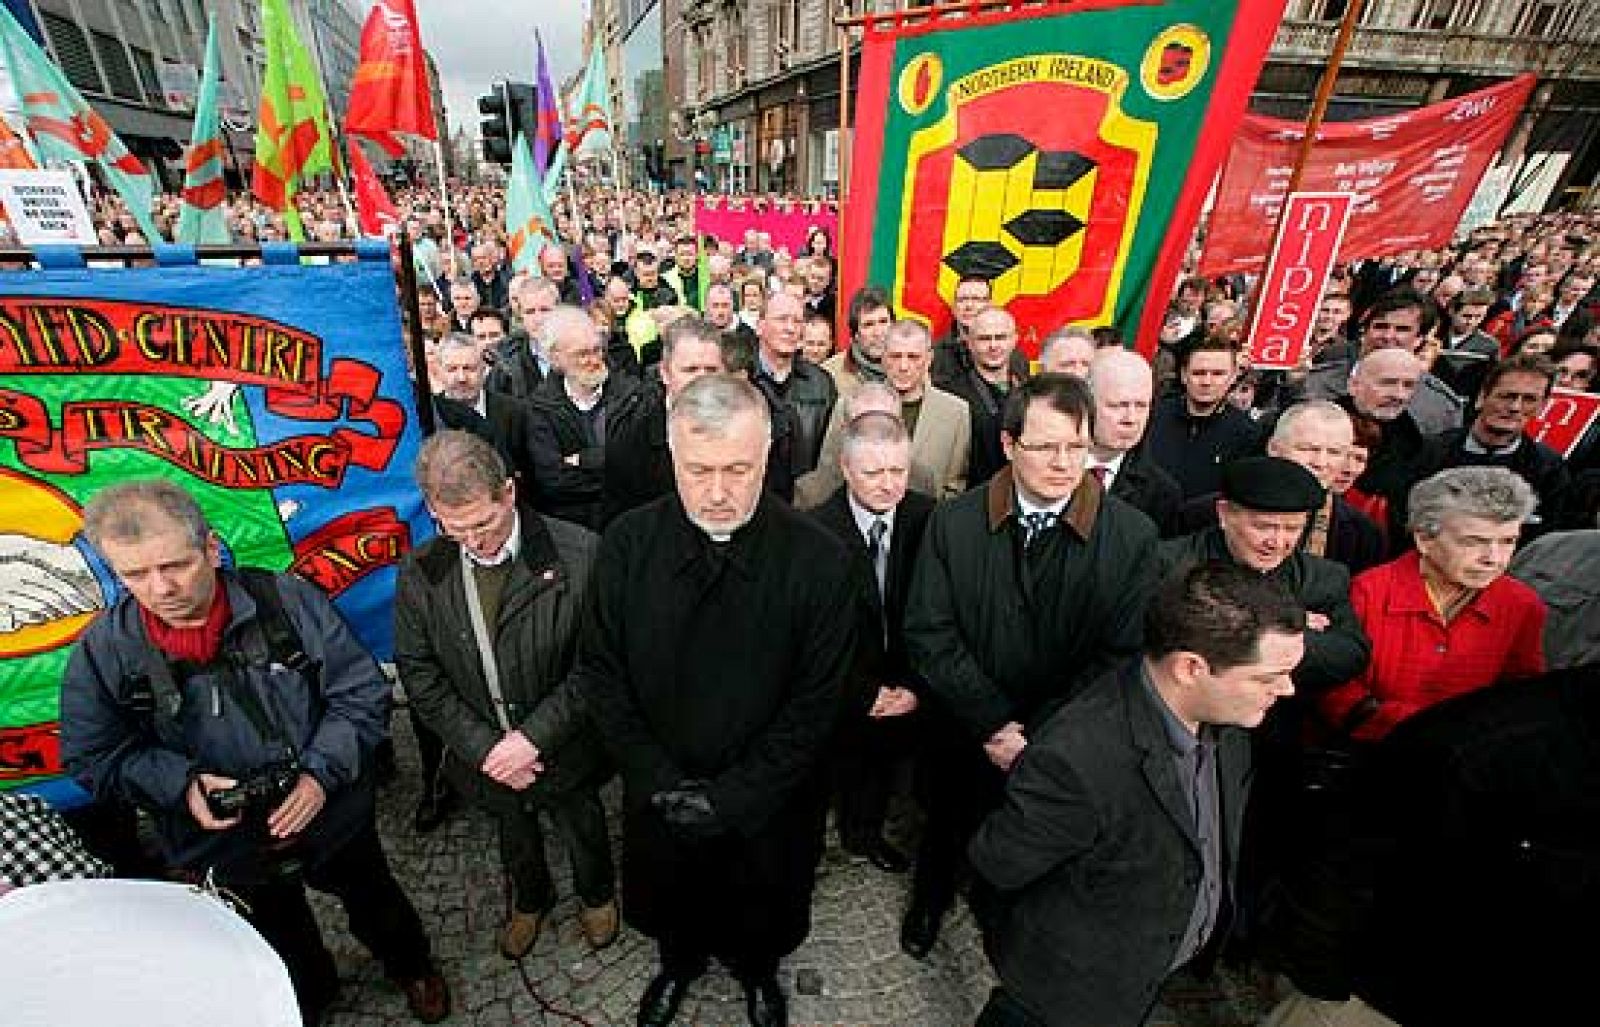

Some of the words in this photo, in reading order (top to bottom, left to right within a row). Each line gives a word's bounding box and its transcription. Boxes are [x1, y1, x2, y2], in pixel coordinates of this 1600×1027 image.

[958, 60, 1040, 97] NORTHERN
[1049, 57, 1116, 88] IRELAND
[1261, 202, 1331, 362] nipsa
[133, 311, 317, 385] CENTRE
[69, 404, 340, 482] TRAINING
